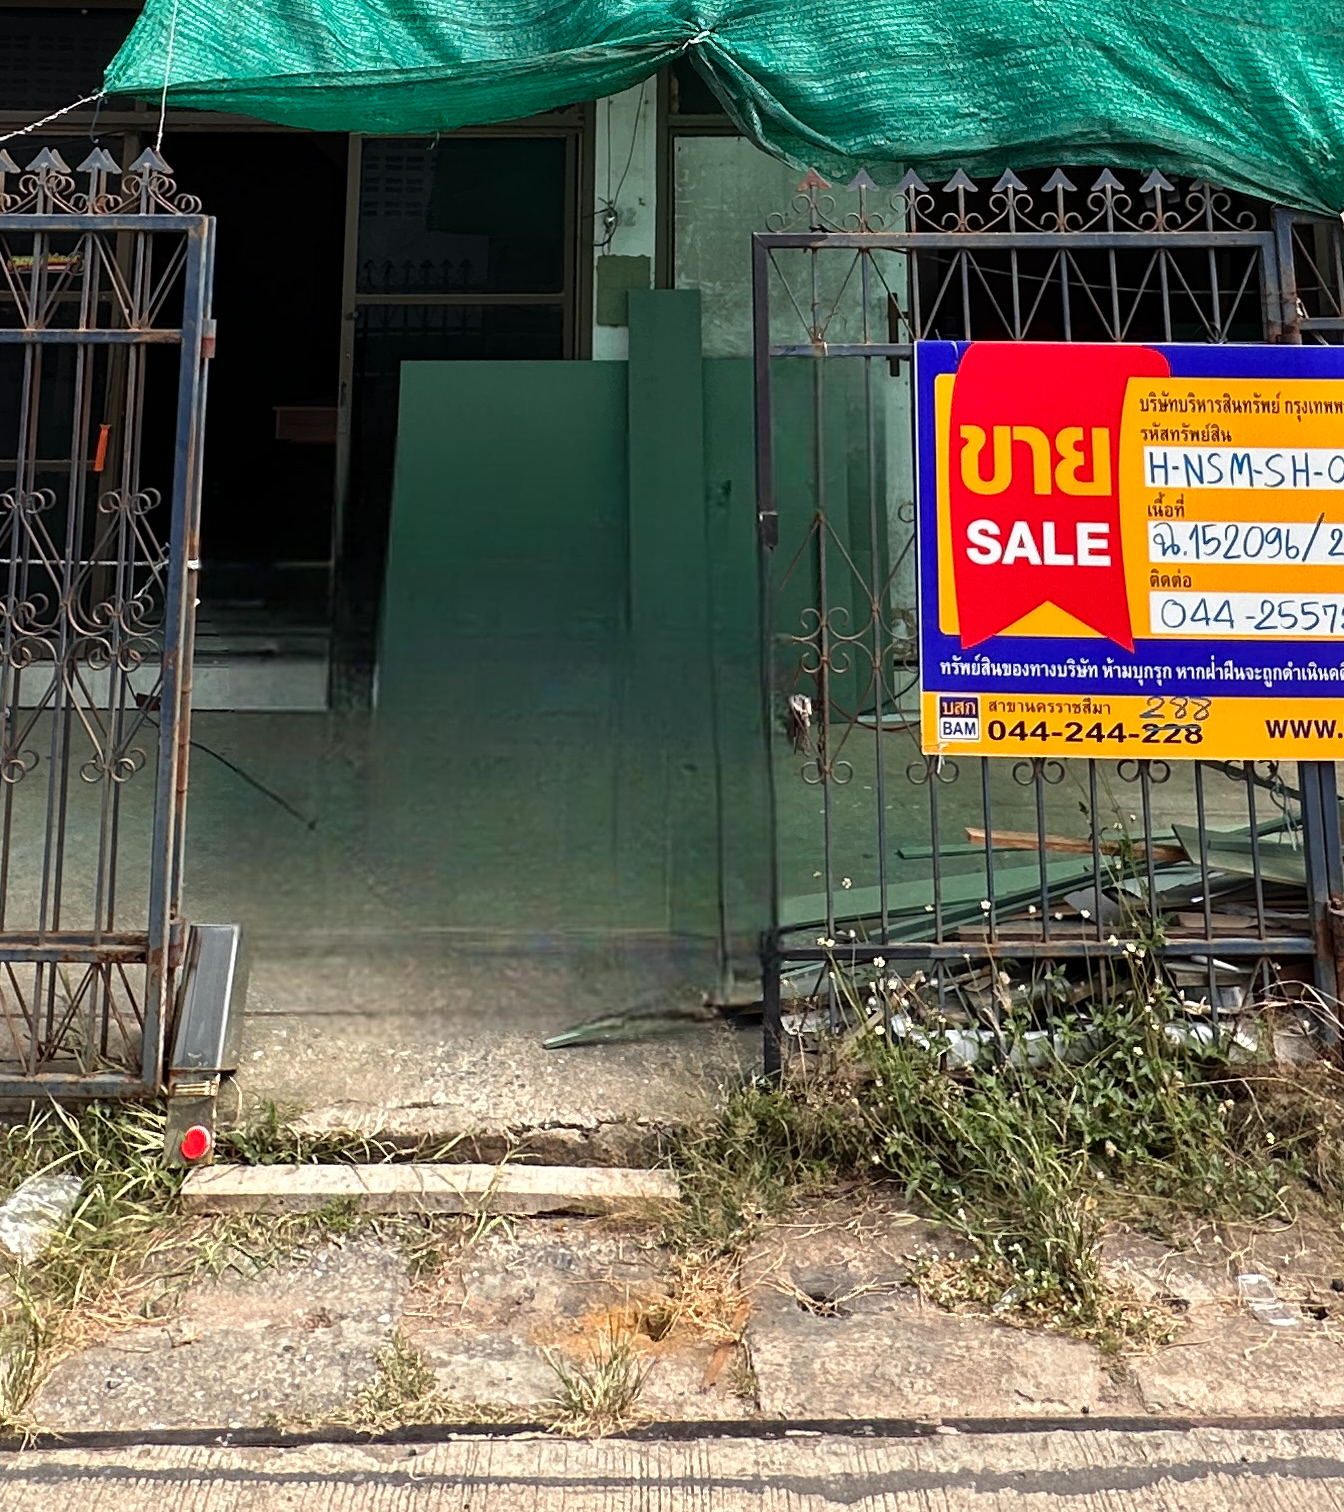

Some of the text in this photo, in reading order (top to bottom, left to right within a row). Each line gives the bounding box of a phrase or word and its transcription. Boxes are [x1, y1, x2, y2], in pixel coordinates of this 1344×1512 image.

[1140, 392, 1280, 415] บริษัทบริหารสินทรัพย์
[1140, 423, 1232, 443] รหัสทรัพย์สิน
[960, 424, 1112, 496] ขาย
[1147, 492, 1185, 518] เนื้อที่
[966, 519, 1112, 567] SALE
[1150, 568, 1192, 588] ติดต่อ
[940, 653, 1099, 678] ทรัพย์สินของทางบริษัท
[1102, 658, 1172, 687] ห้ามบุกรุก
[942, 698, 977, 716] บสก
[988, 698, 1111, 716] สาขานครราชสีมา
[943, 720, 977, 737] BAM
